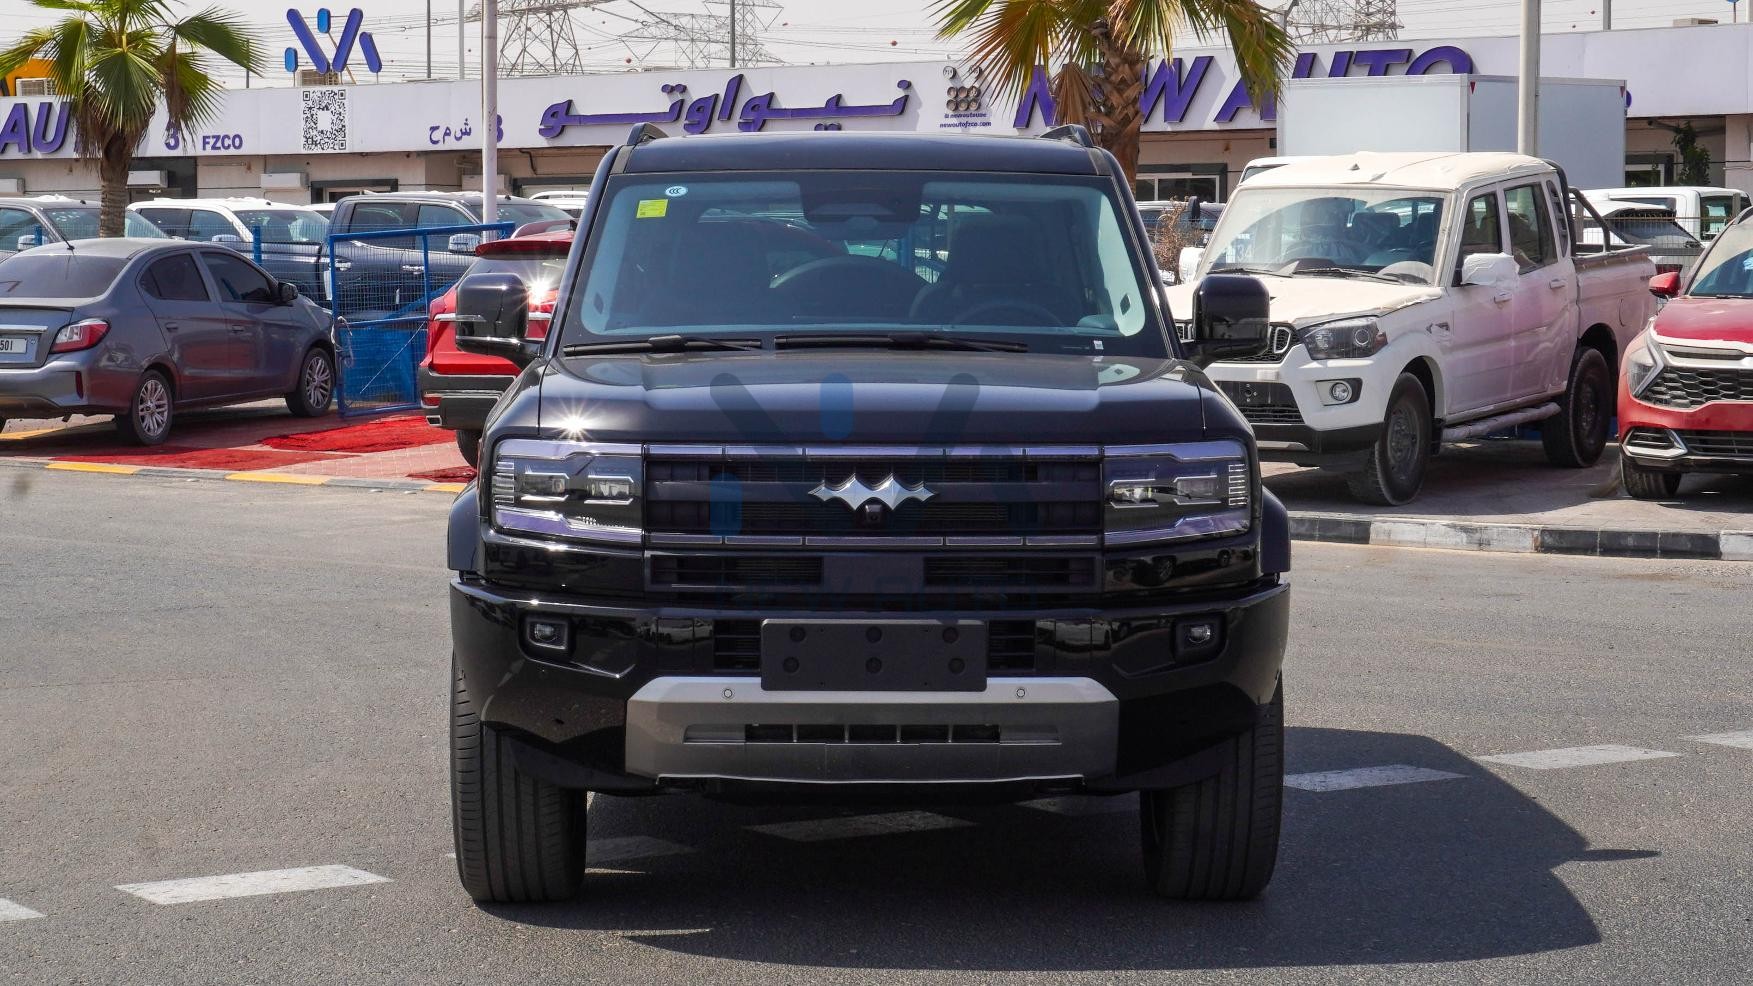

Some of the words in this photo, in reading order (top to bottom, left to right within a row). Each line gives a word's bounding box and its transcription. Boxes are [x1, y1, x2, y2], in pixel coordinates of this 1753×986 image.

[1012, 55, 1215, 130] NW
[0, 101, 83, 155] AU
[202, 133, 243, 151] FZCO
